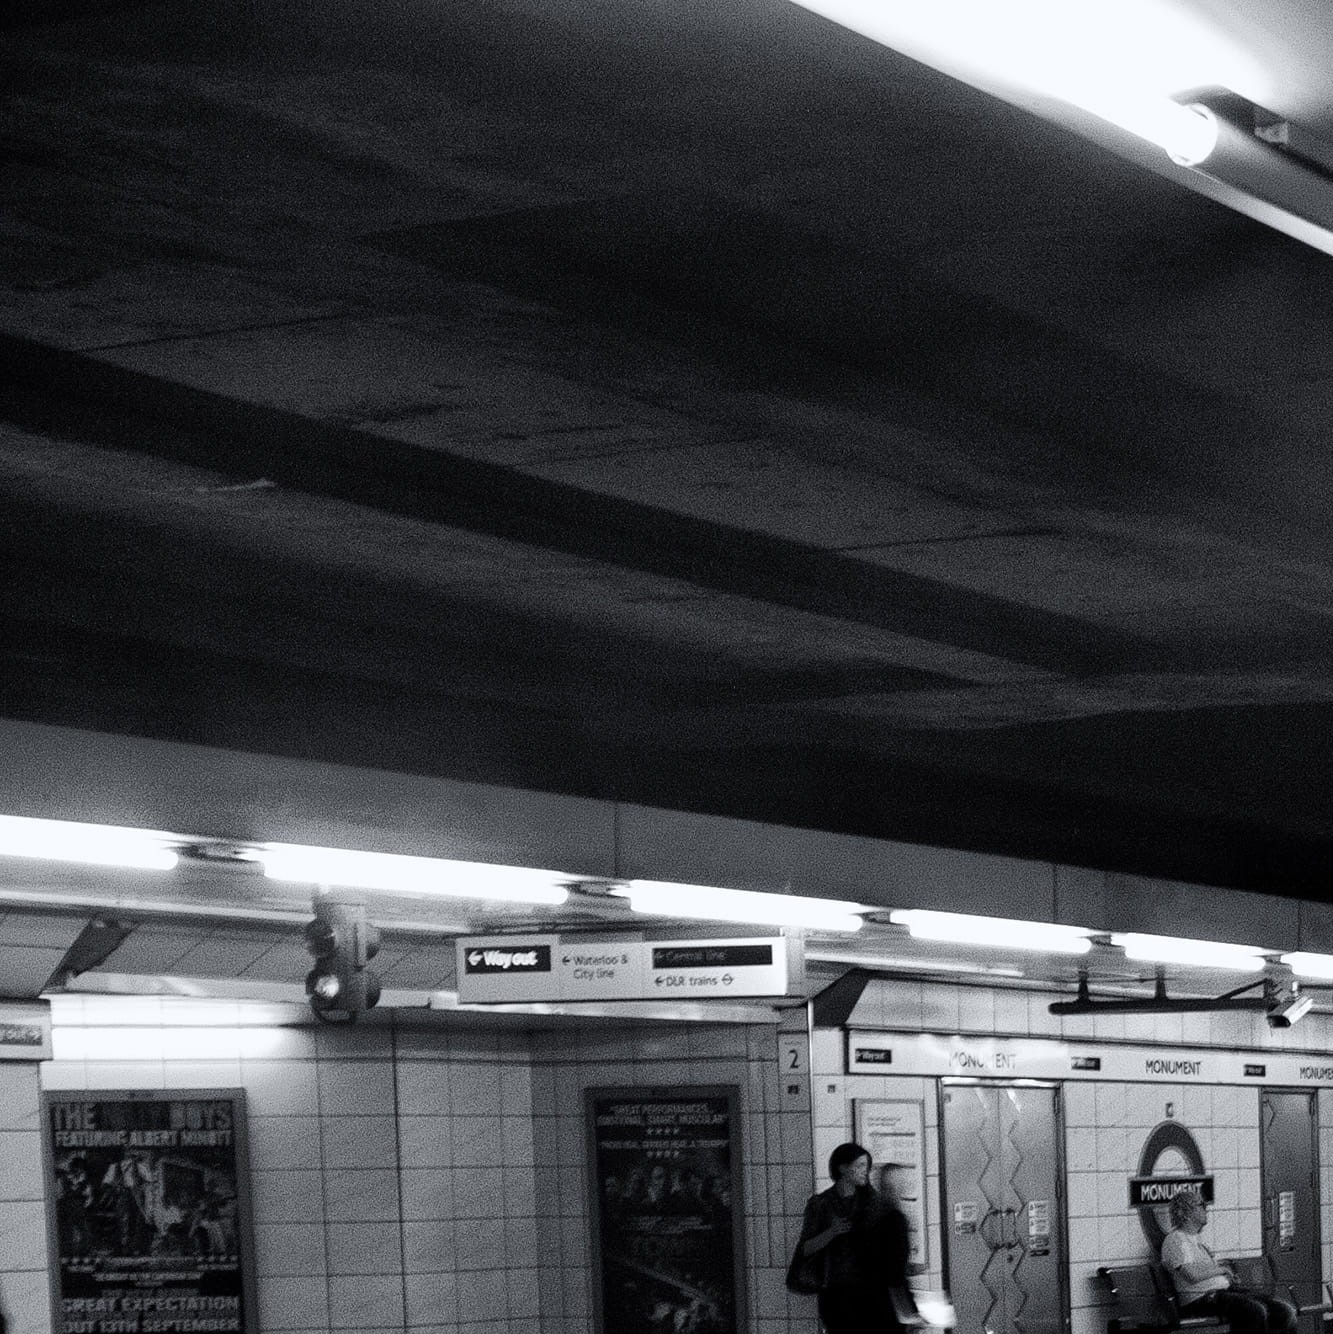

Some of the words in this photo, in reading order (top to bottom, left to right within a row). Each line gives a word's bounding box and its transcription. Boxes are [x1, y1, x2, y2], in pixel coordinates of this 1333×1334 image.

[483, 950, 512, 969] Way
[512, 951, 538, 966] out
[573, 955, 618, 966] Waterloo
[573, 968, 594, 981] City
[597, 969, 615, 979] line
[689, 976, 718, 986] trains
[788, 1050, 800, 1068] 2
[1145, 1060, 1201, 1075] MONUMENT
[54, 1102, 96, 1131] THE
[62, 1299, 115, 1312] GREAT
[142, 1318, 239, 1332] SEPTEMBER
